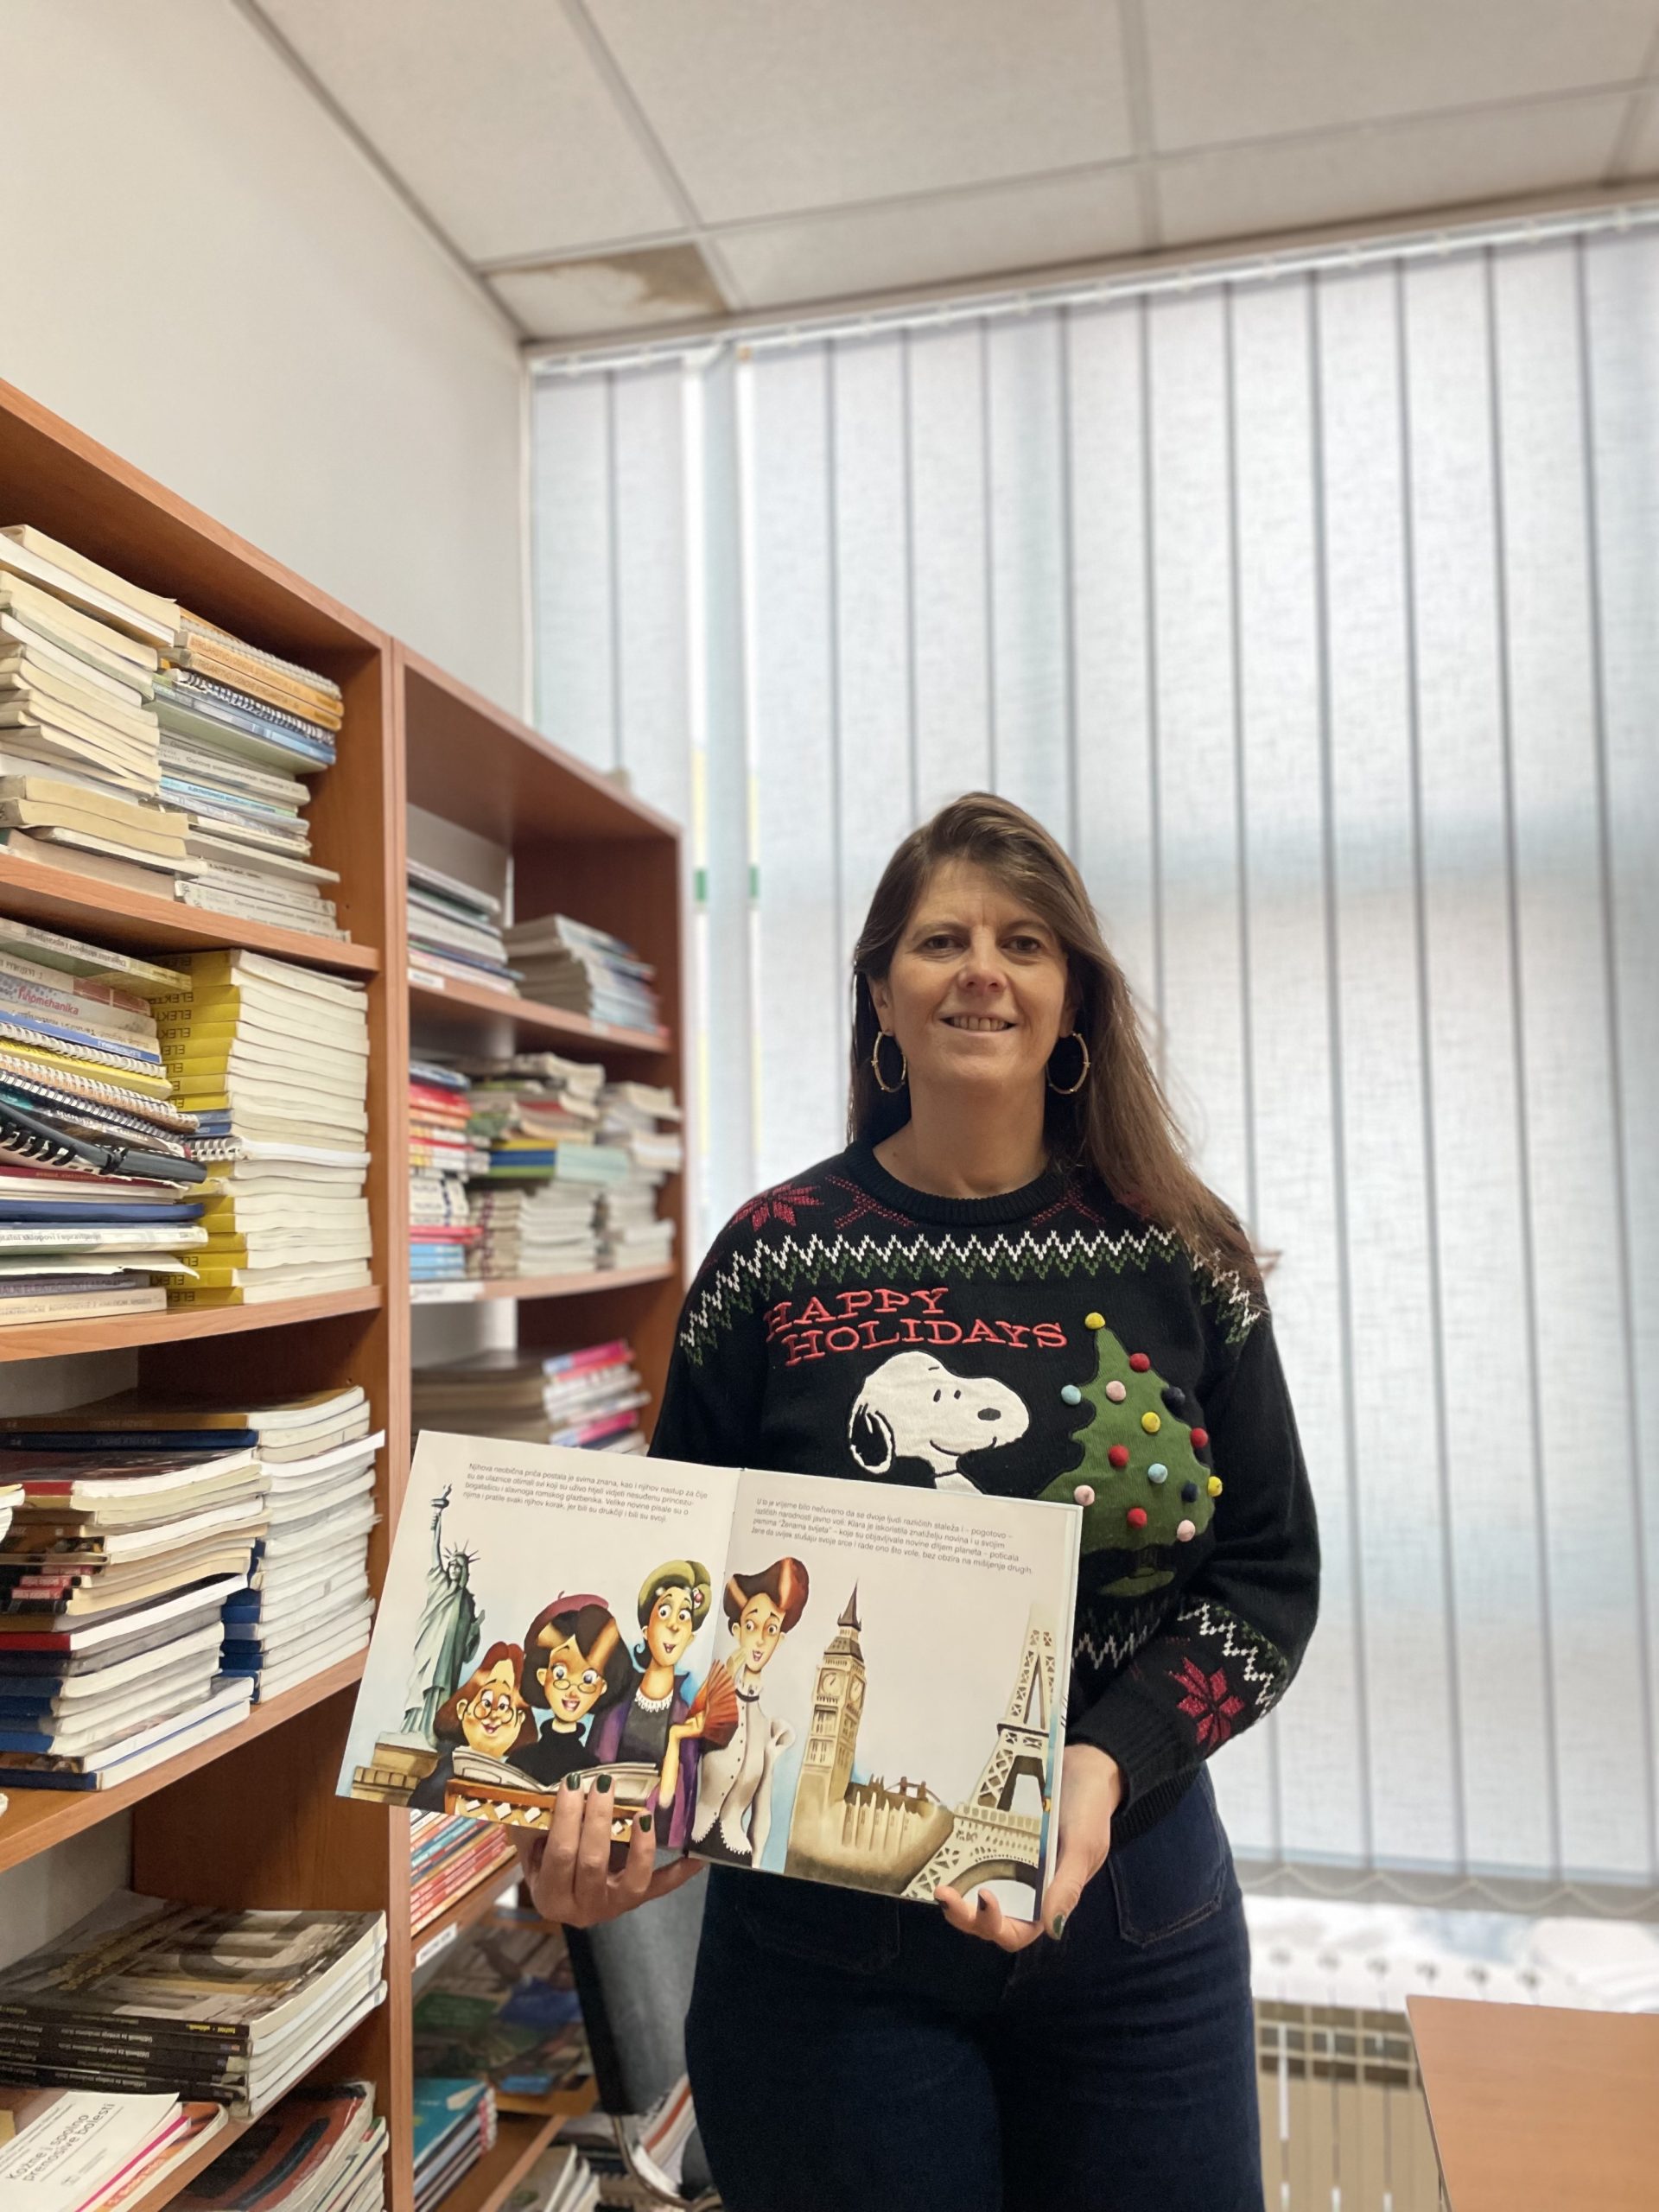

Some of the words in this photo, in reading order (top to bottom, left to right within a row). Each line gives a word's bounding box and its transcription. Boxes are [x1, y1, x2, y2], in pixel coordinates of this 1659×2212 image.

[763, 1287, 949, 1343] HAPPY
[781, 1319, 1068, 1367] HOLIDAYS
[465, 1481, 500, 1491] bogatašicu
[505, 1486, 534, 1496] slavnoga
[652, 1504, 671, 1513] pisale
[469, 1463, 493, 1471] Njihova
[494, 1466, 524, 1475] neobična
[661, 1487, 683, 1497] nastup
[696, 1491, 708, 1499] čije
[486, 1474, 512, 1483] ulaznice
[546, 1481, 558, 1490] koji
[588, 1486, 604, 1495] htjeli
[606, 1489, 625, 1497] vidjeti
[626, 1492, 660, 1502] nesuđenu
[599, 1507, 623, 1517] drukčiji
[776, 1501, 797, 1510] vrijeme
[812, 1506, 844, 1516] nečuveno
[867, 1513, 885, 1522] dvoje
[934, 1522, 959, 1532] staleža
[971, 1529, 1007, 1538] pogotovo
[779, 1512, 811, 1521] narodnosti
[813, 1515, 830, 1523] javno
[848, 1520, 865, 1529] Klara
[875, 1523, 907, 1535] iskoristila
[944, 1535, 969, 1543] novina
[794, 1533, 817, 1542] slušaju
[938, 1554, 960, 1562] obzira
[974, 1560, 1006, 1570] mišljenje
[839, 1529, 854, 1538] koje
[866, 1533, 904, 1544] objavljivale
[931, 1541, 952, 1551] diljem
[955, 1546, 982, 1555] planeta
[989, 1552, 1019, 1560] poticala
[6, 2151, 46, 2181] Kožne
[50, 2113, 90, 2146] spolno
[22, 2135, 77, 2182] prenosive
[75, 2102, 116, 2135] bolesti
